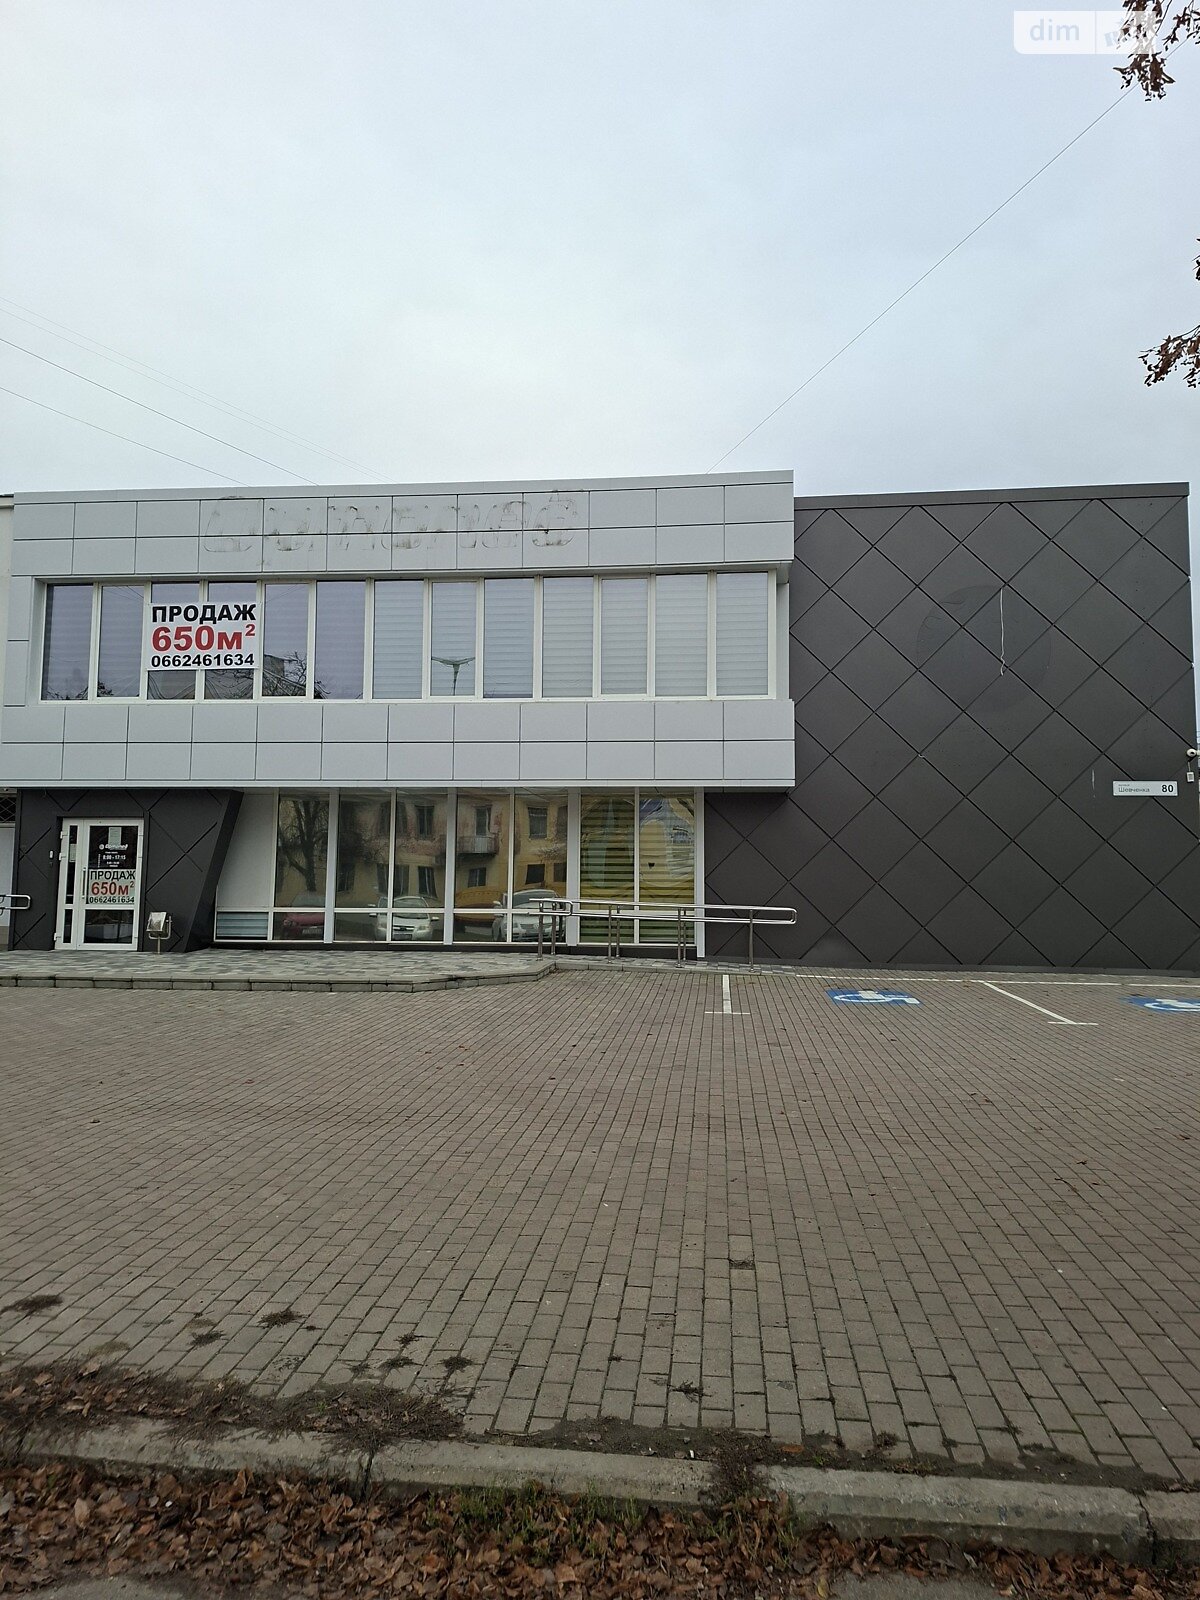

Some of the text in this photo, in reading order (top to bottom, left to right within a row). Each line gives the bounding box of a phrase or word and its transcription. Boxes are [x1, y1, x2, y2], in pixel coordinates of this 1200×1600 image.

[152, 604, 257, 625] ПРОДАЖ
[151, 653, 255, 668] 0662461634
[1161, 784, 1174, 793] 80
[90, 870, 136, 881] ПРОДАЖ
